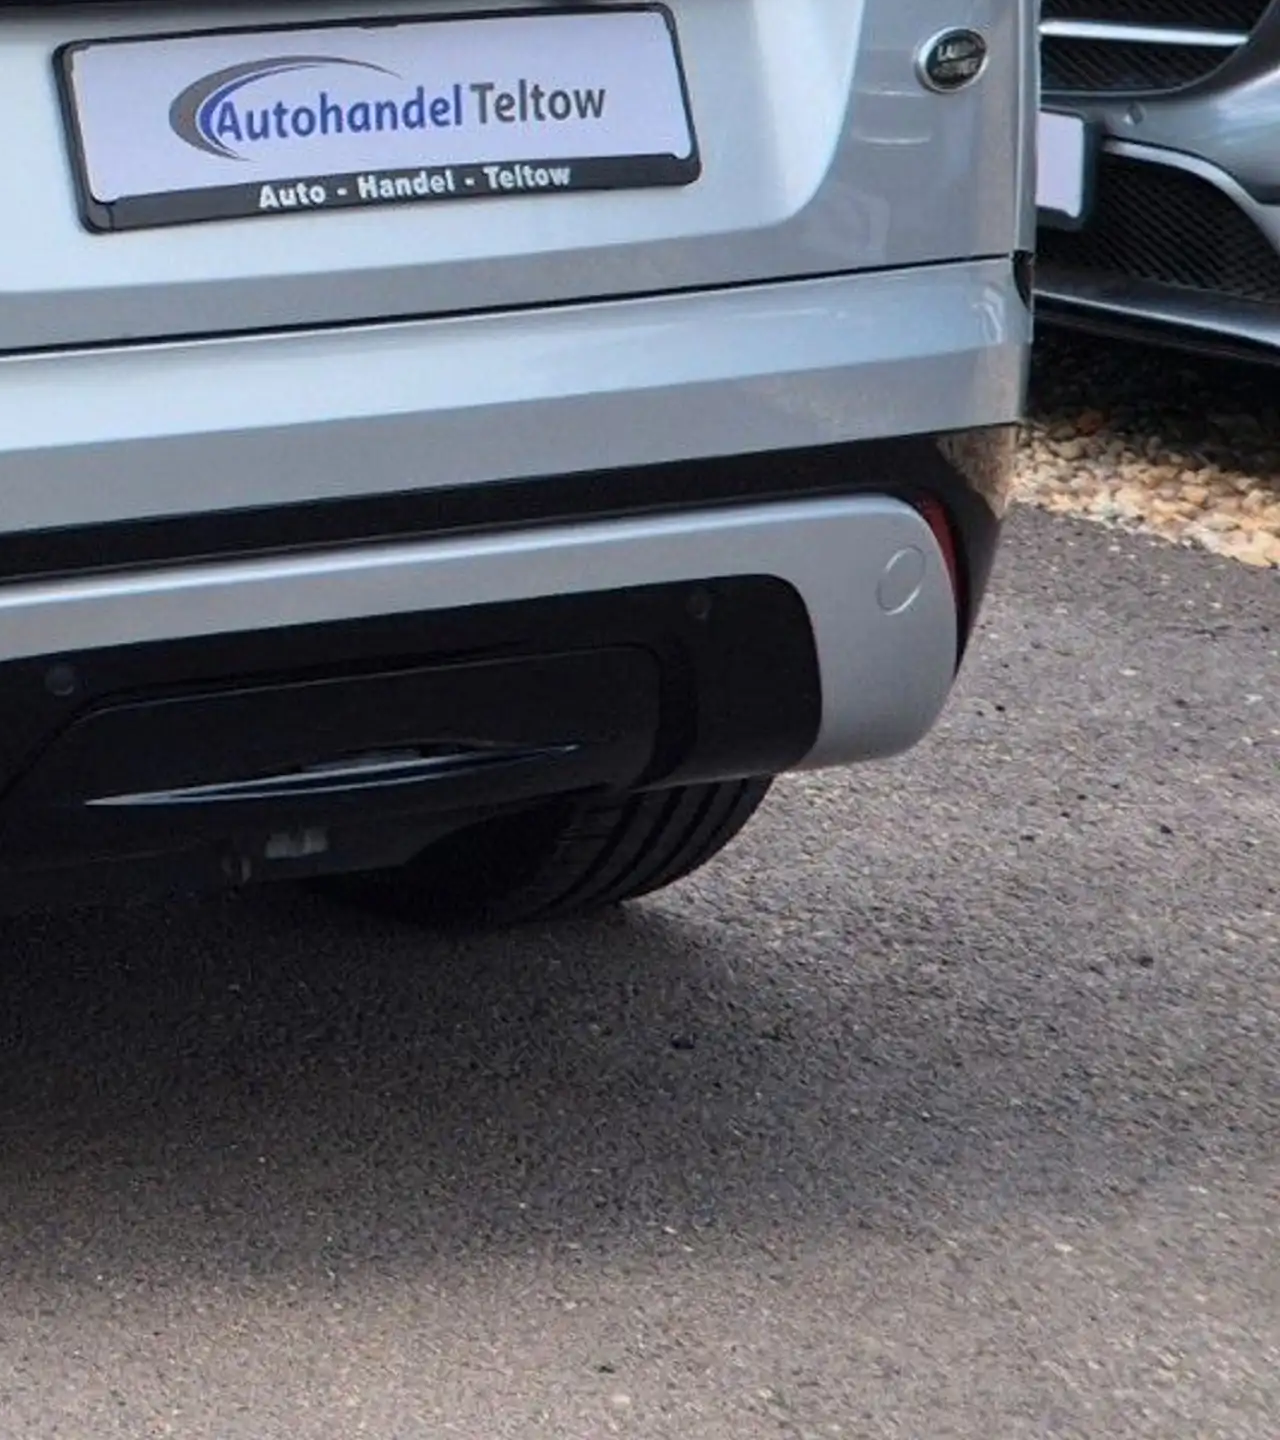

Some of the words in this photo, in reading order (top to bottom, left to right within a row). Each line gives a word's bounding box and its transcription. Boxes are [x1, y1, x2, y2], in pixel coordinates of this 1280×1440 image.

[259, 182, 326, 210] Auto
[357, 171, 454, 199] Handel
[486, 163, 571, 189] Teltow
